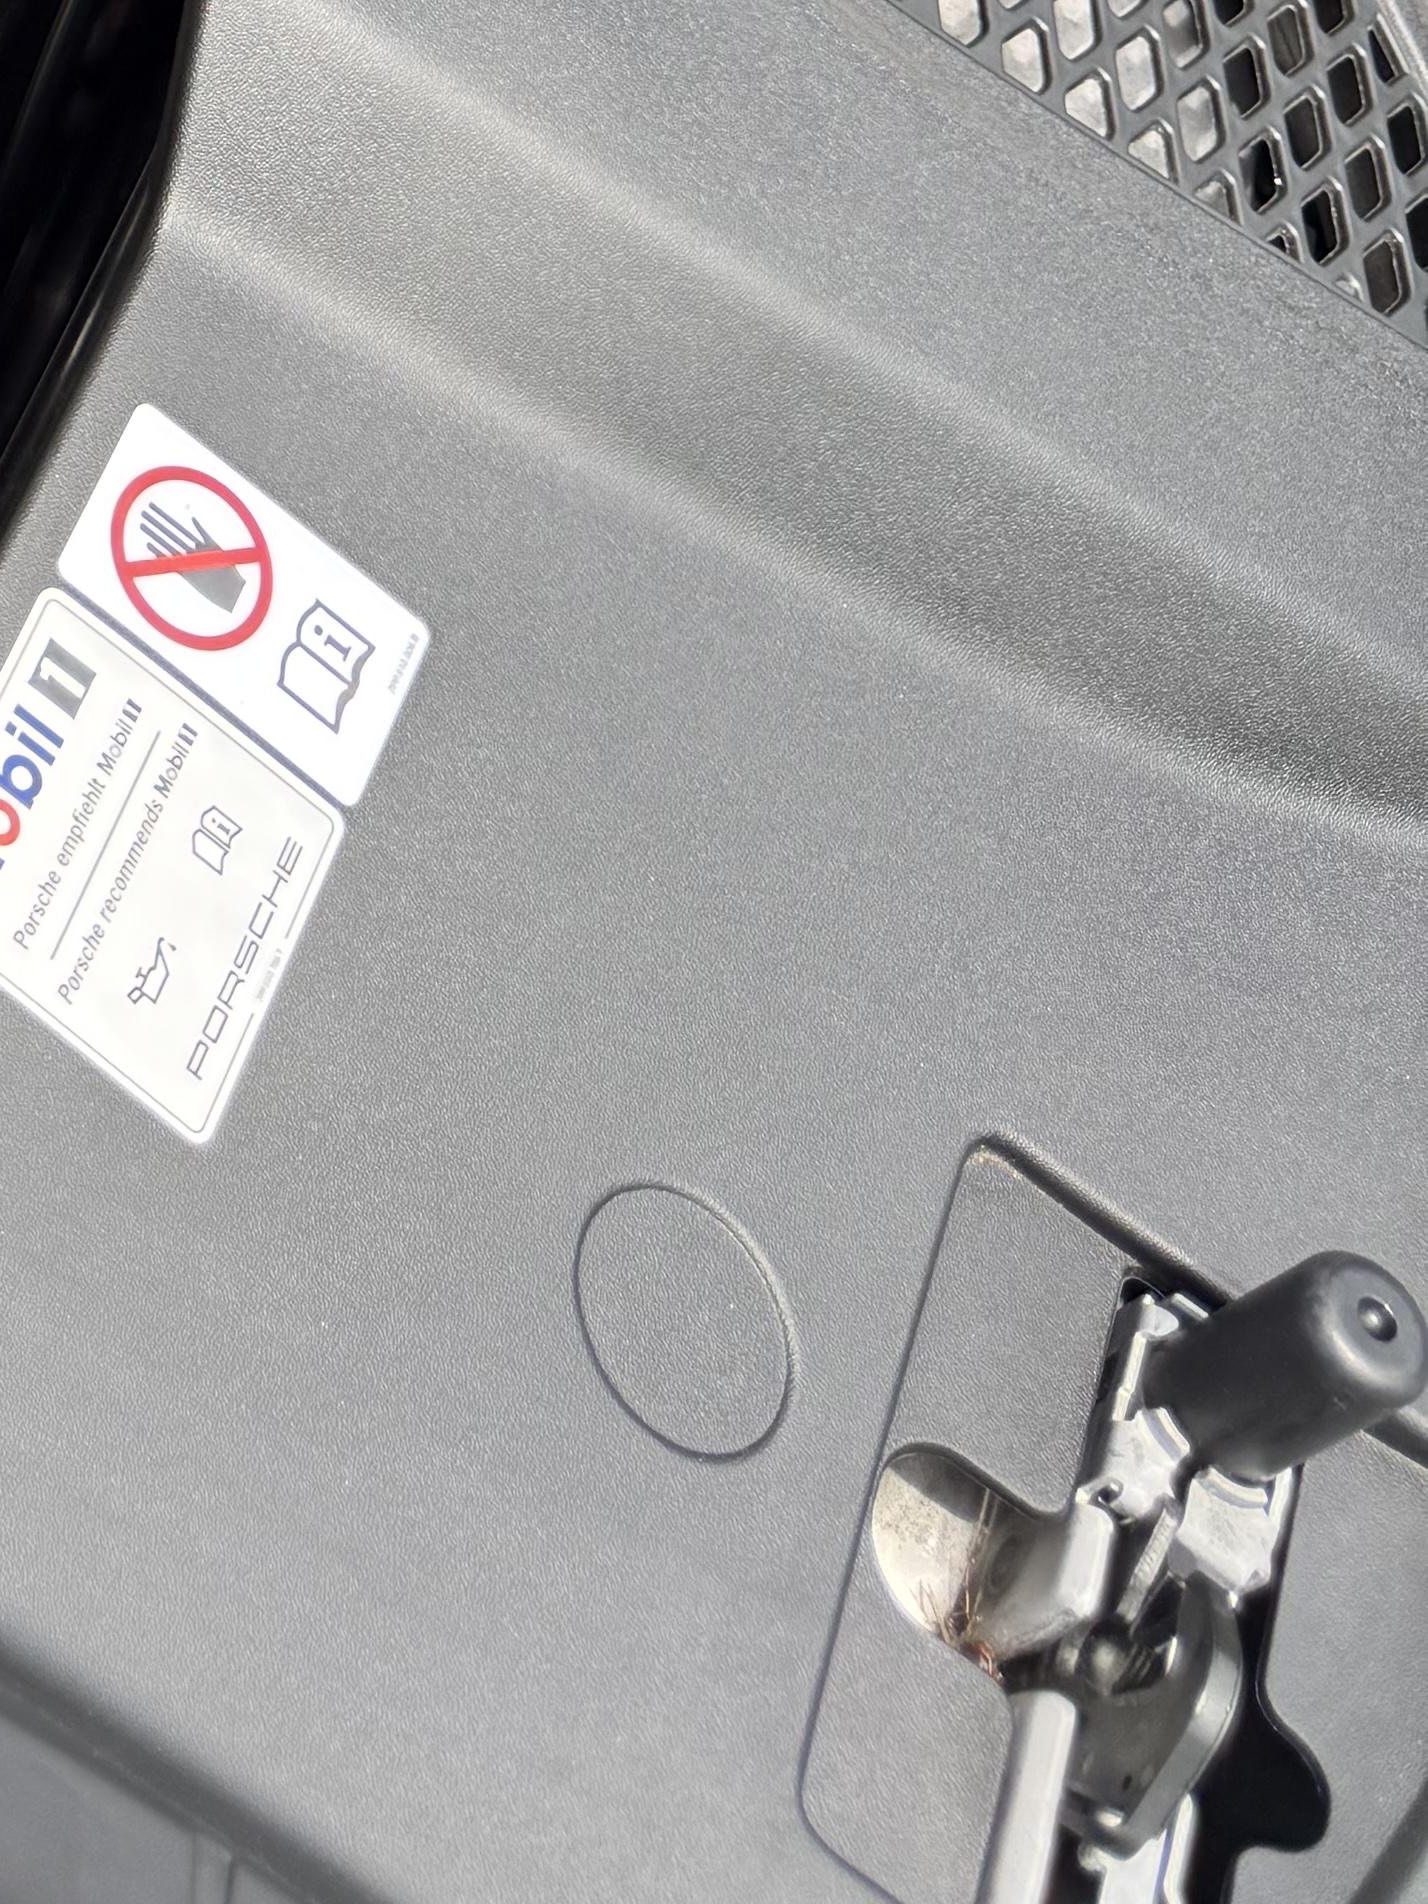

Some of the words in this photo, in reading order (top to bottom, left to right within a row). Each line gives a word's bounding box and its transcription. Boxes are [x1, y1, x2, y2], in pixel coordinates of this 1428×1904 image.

[27, 637, 98, 721] 1
[12, 870, 62, 951] Porsche
[56, 777, 107, 868] empfiehlt
[57, 923, 106, 1006] Porsche
[99, 798, 164, 925] recommends
[185, 835, 304, 1081] PORSCHE
